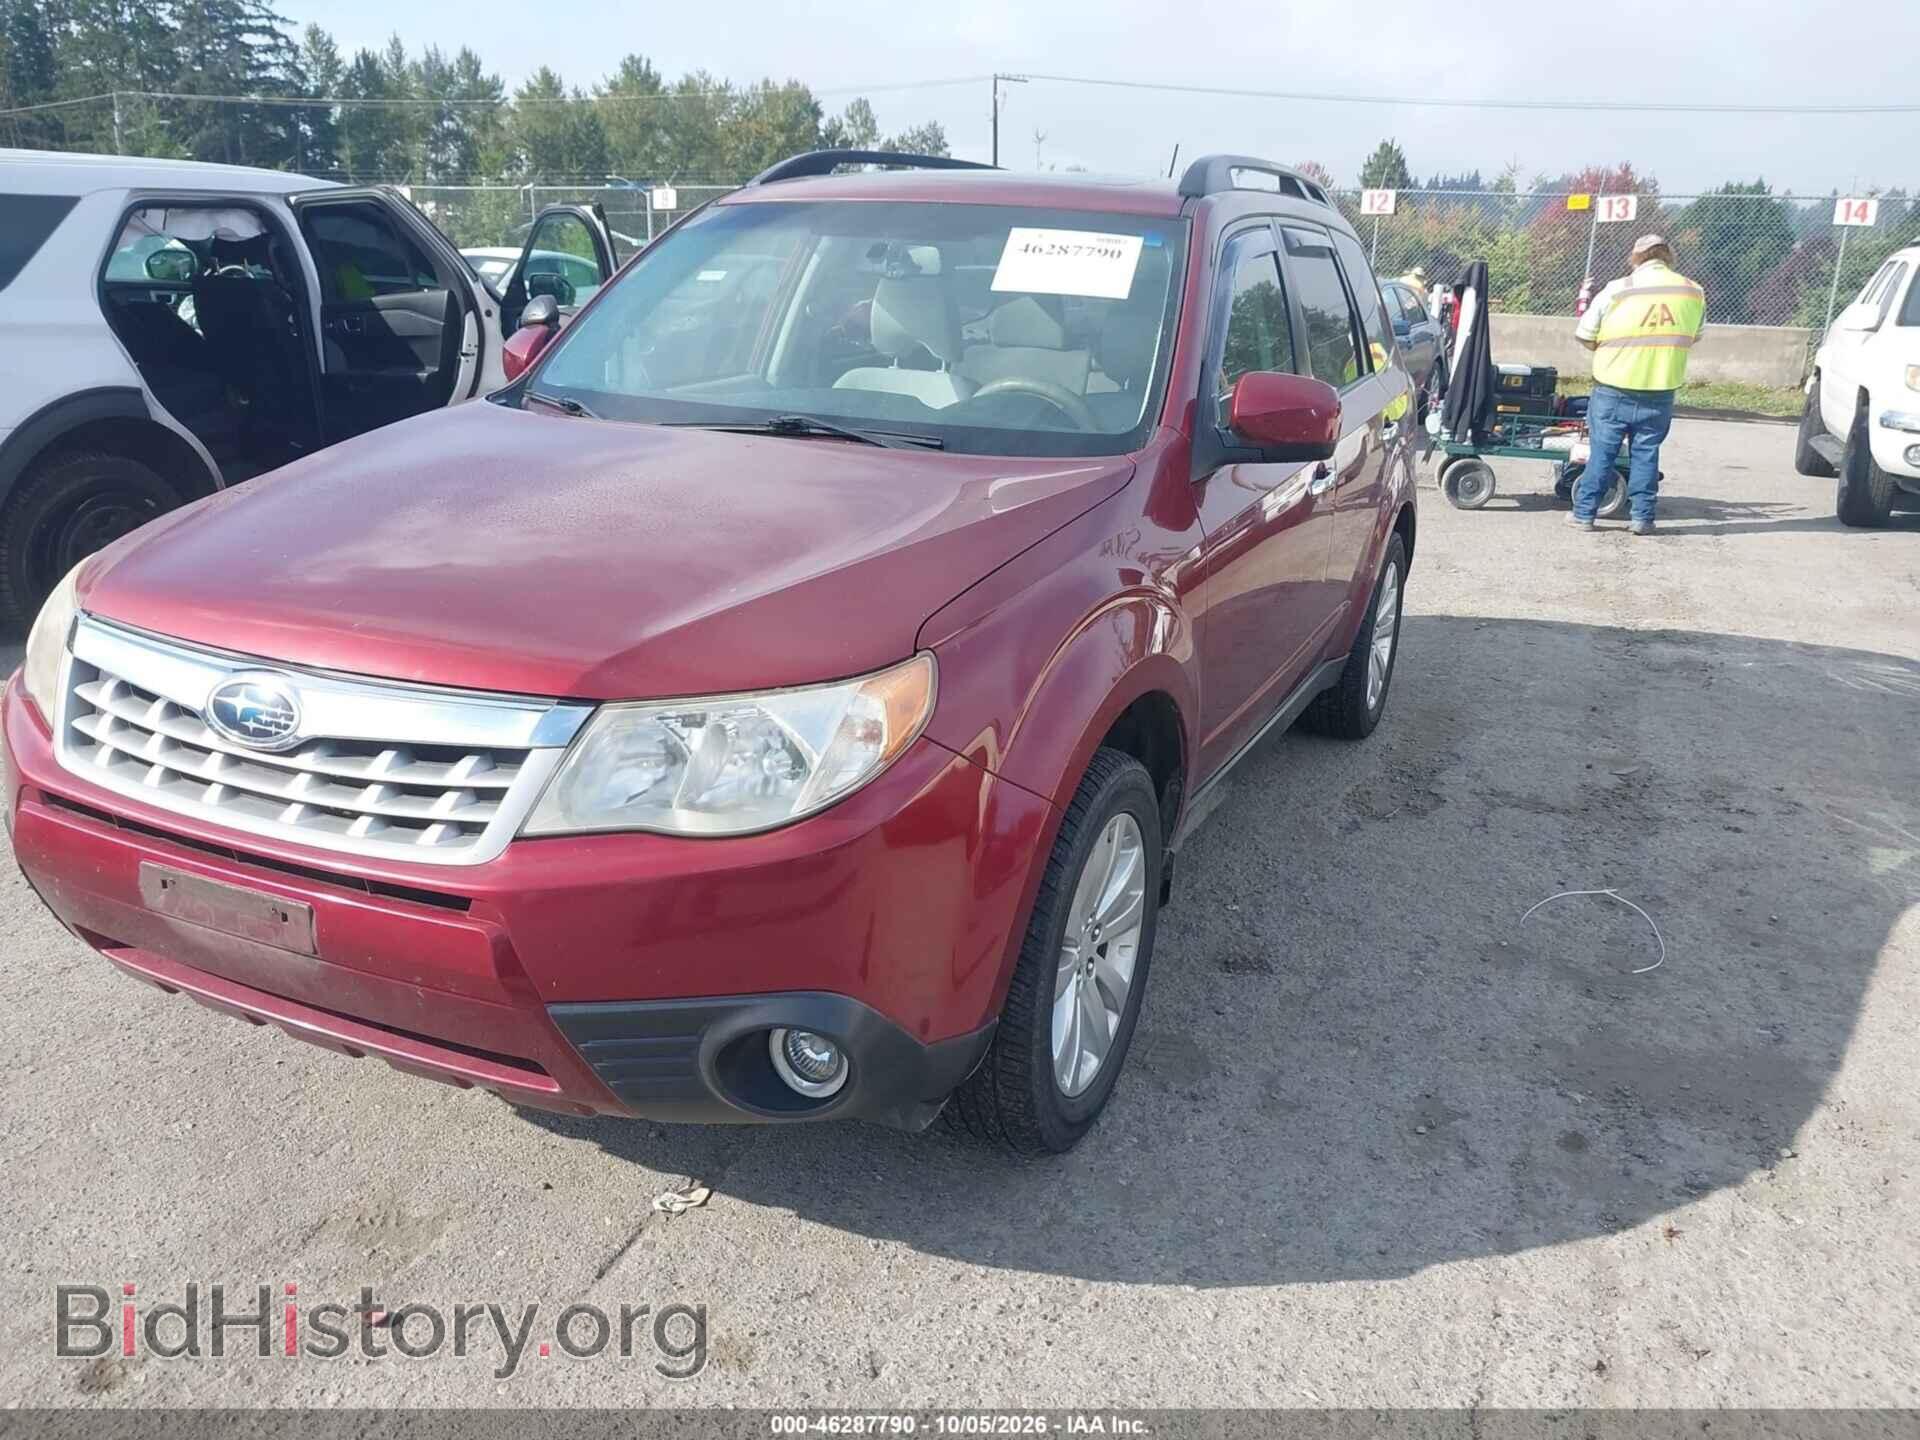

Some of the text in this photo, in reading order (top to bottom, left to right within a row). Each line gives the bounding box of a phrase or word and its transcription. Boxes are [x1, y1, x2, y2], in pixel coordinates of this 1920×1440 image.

[1370, 192, 1389, 211] 12
[1607, 197, 1629, 219] 13
[1844, 200, 1868, 223] 14
[1018, 243, 1122, 259] 46287790
